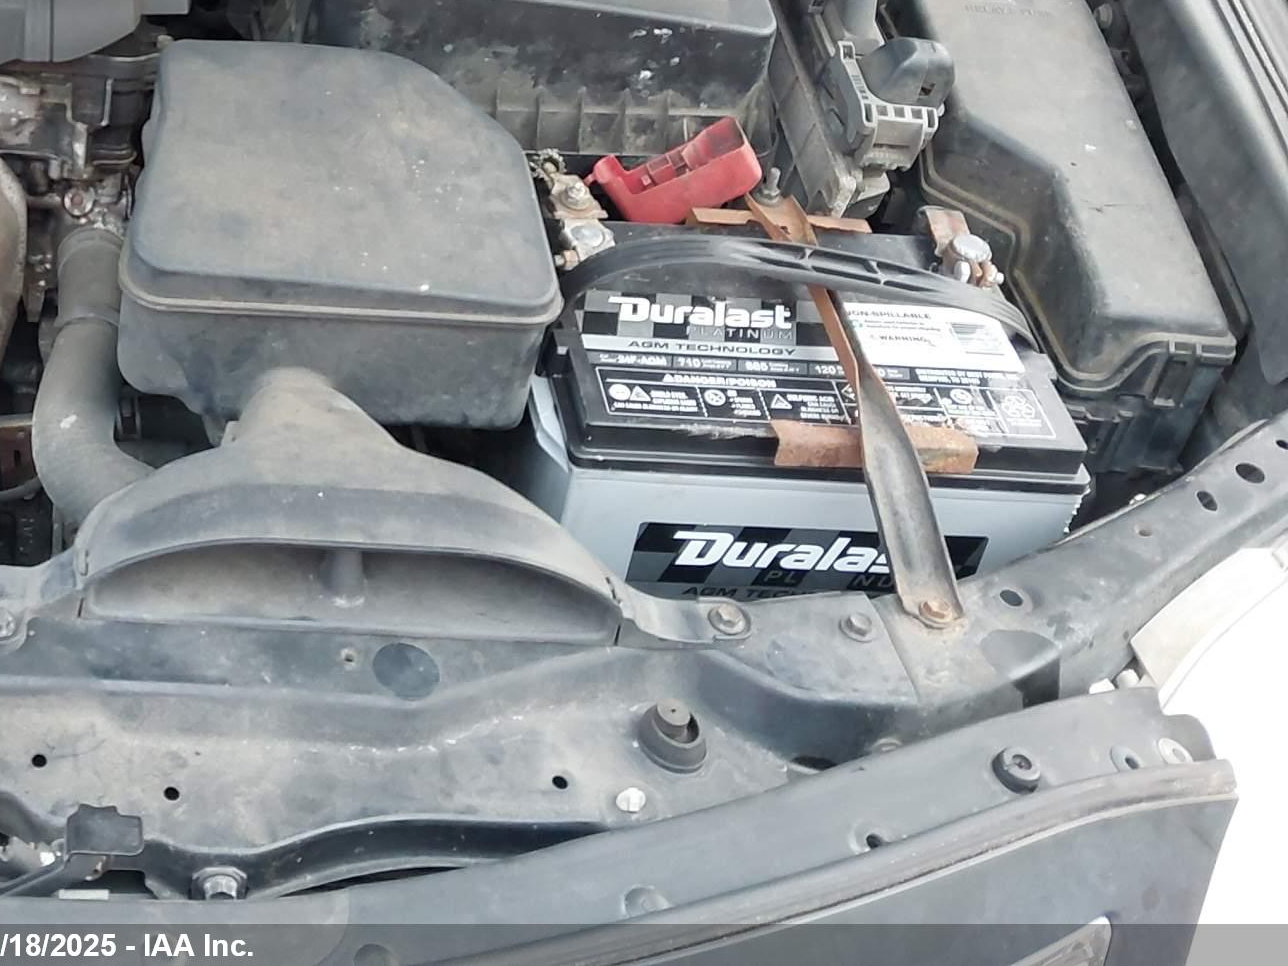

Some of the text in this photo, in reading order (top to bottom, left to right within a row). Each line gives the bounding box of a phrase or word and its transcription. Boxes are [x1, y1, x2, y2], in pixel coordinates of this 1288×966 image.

[608, 296, 793, 329] Duralast
[686, 325, 794, 340] PLATINUM
[628, 340, 797, 357] AGM TECHNOLOGY
[815, 365, 836, 375] 120
